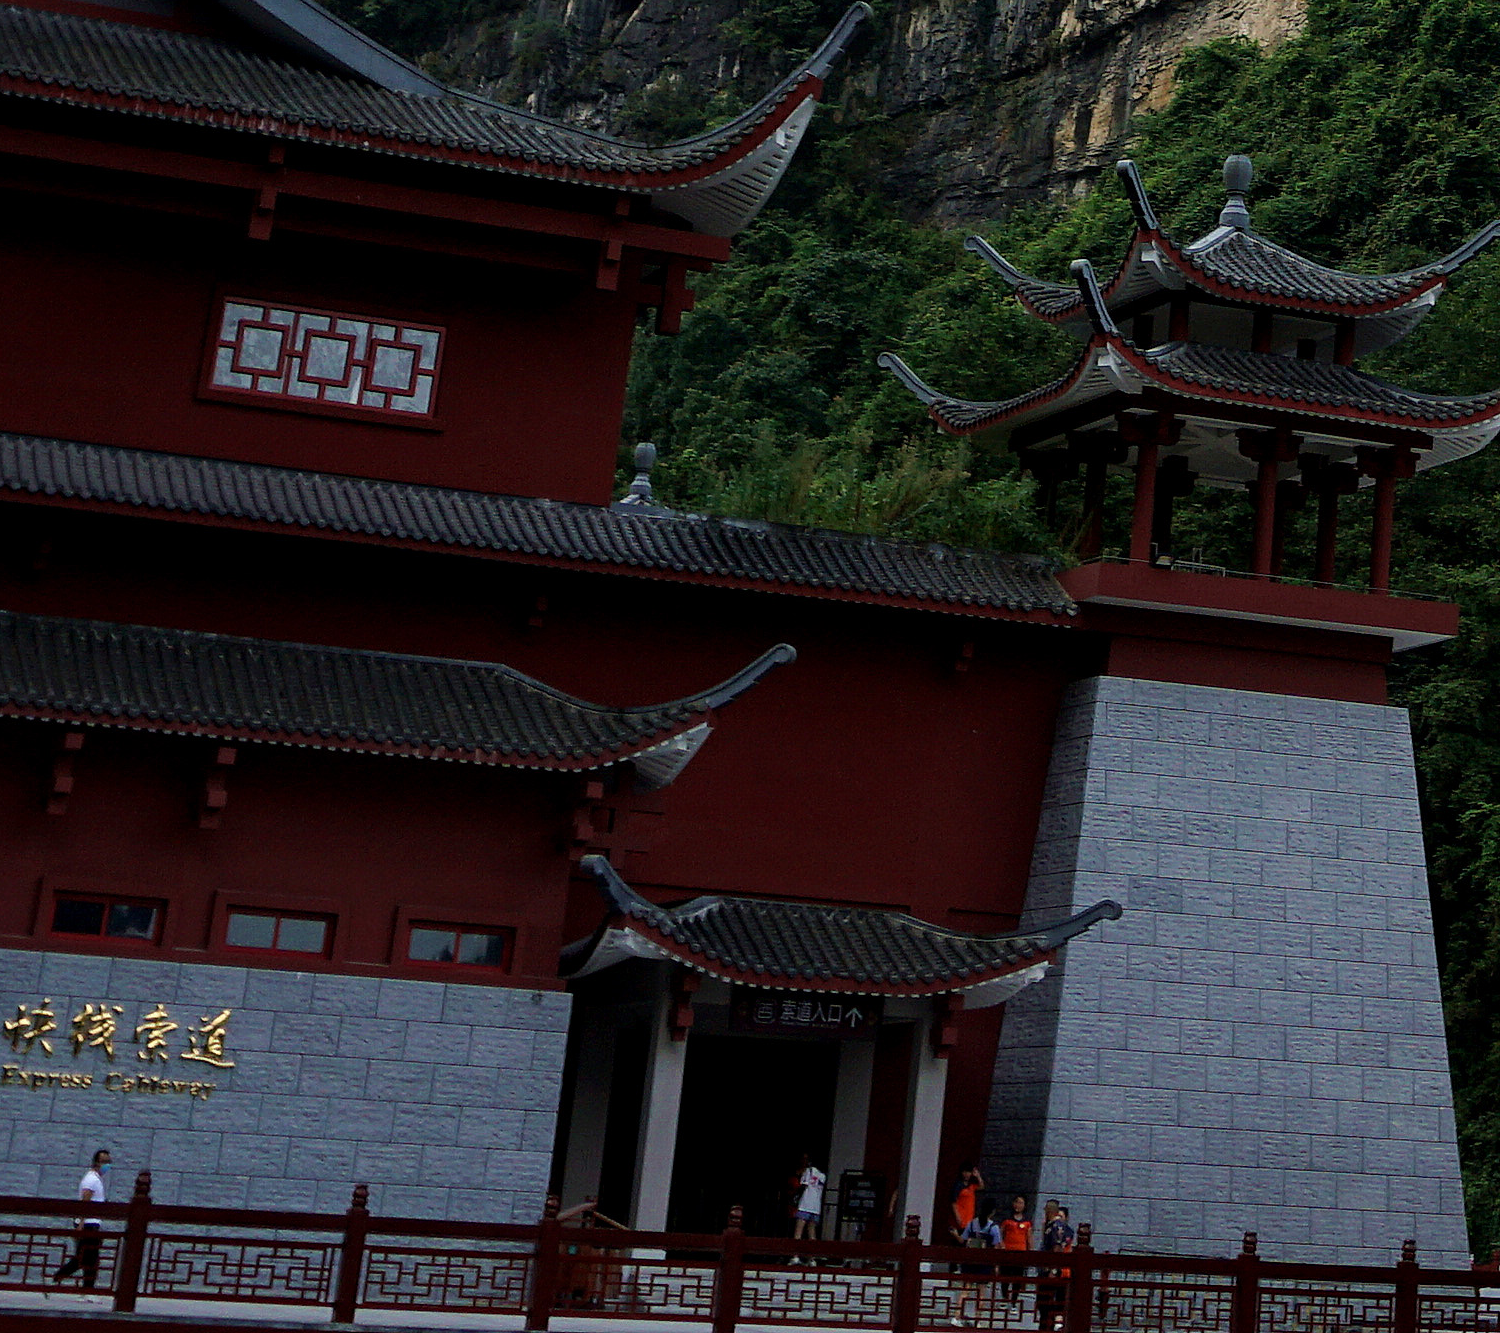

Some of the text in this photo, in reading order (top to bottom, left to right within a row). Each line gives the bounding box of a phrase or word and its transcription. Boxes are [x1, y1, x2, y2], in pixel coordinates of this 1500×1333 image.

[780, 999, 842, 1023] 索道入口
[1, 1064, 93, 1092] Express
[106, 1071, 217, 1100] Cableway
